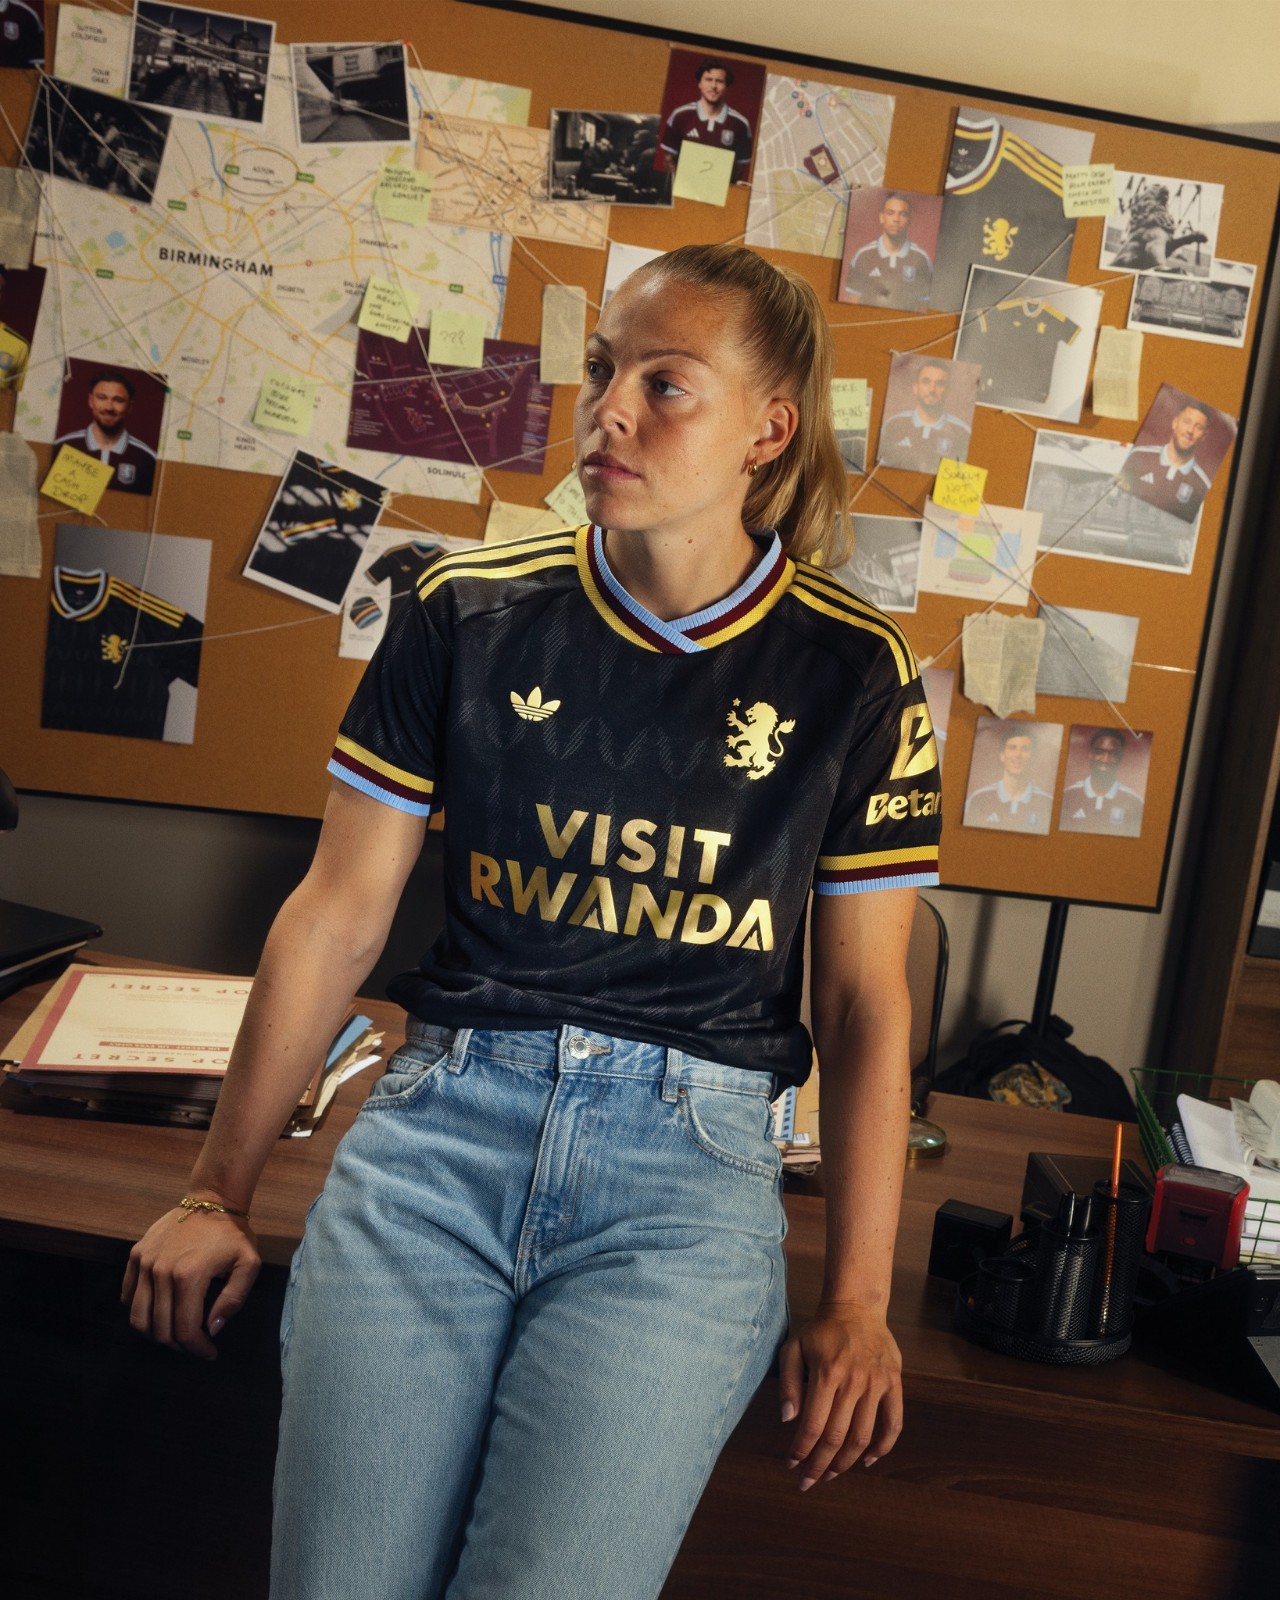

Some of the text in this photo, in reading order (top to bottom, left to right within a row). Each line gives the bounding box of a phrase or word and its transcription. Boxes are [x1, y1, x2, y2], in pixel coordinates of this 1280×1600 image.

[158, 247, 274, 278] BIRMINGHAM
[865, 789, 943, 826] Betan
[535, 803, 732, 885] VISIT
[470, 850, 775, 952] RWANDA
[107, 983, 201, 993] SECRET
[72, 1053, 229, 1065] OP SECRET
